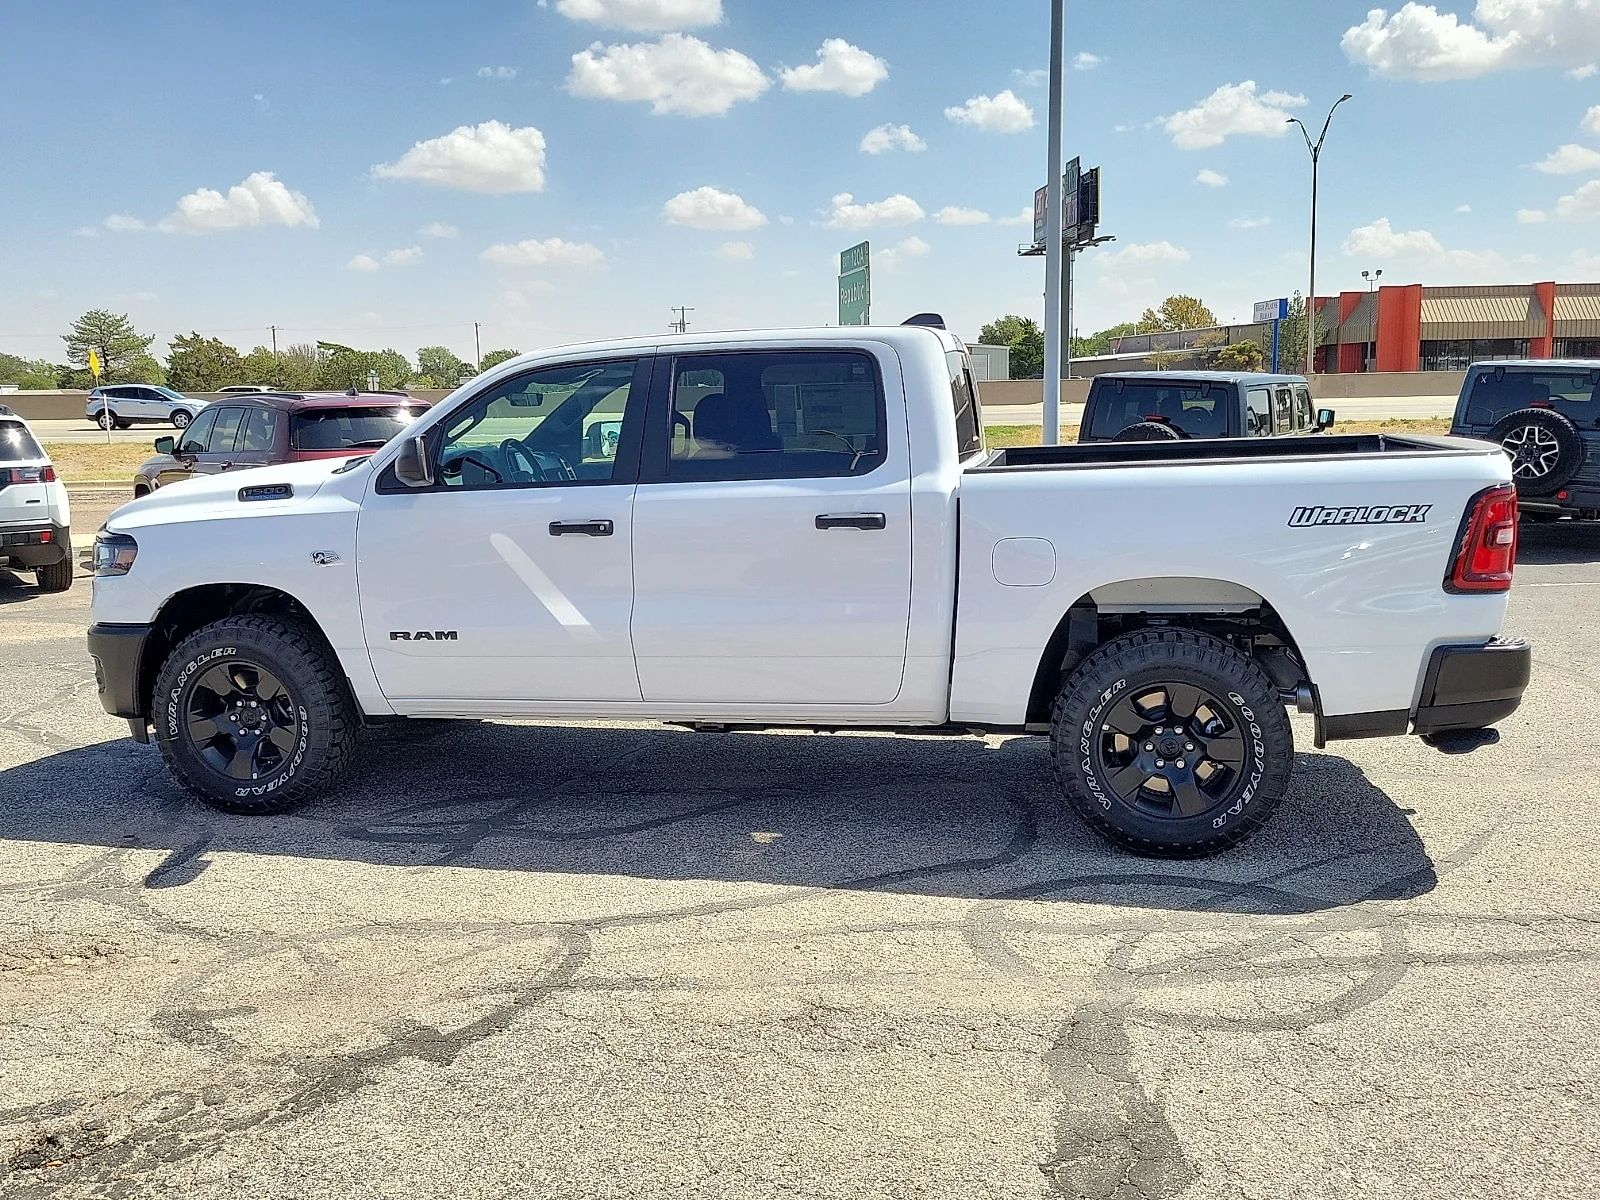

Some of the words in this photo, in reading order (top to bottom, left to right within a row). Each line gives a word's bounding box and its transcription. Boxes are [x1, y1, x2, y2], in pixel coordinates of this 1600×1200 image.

[840, 281, 864, 308] Republic
[1287, 504, 1433, 527] WARLOCK
[389, 631, 458, 641] RAM
[168, 647, 237, 736] WRANGLER
[234, 705, 309, 796] GOODYEAR
[1080, 678, 1127, 811] WRANGLER
[1212, 691, 1265, 829] GOODYEAR
